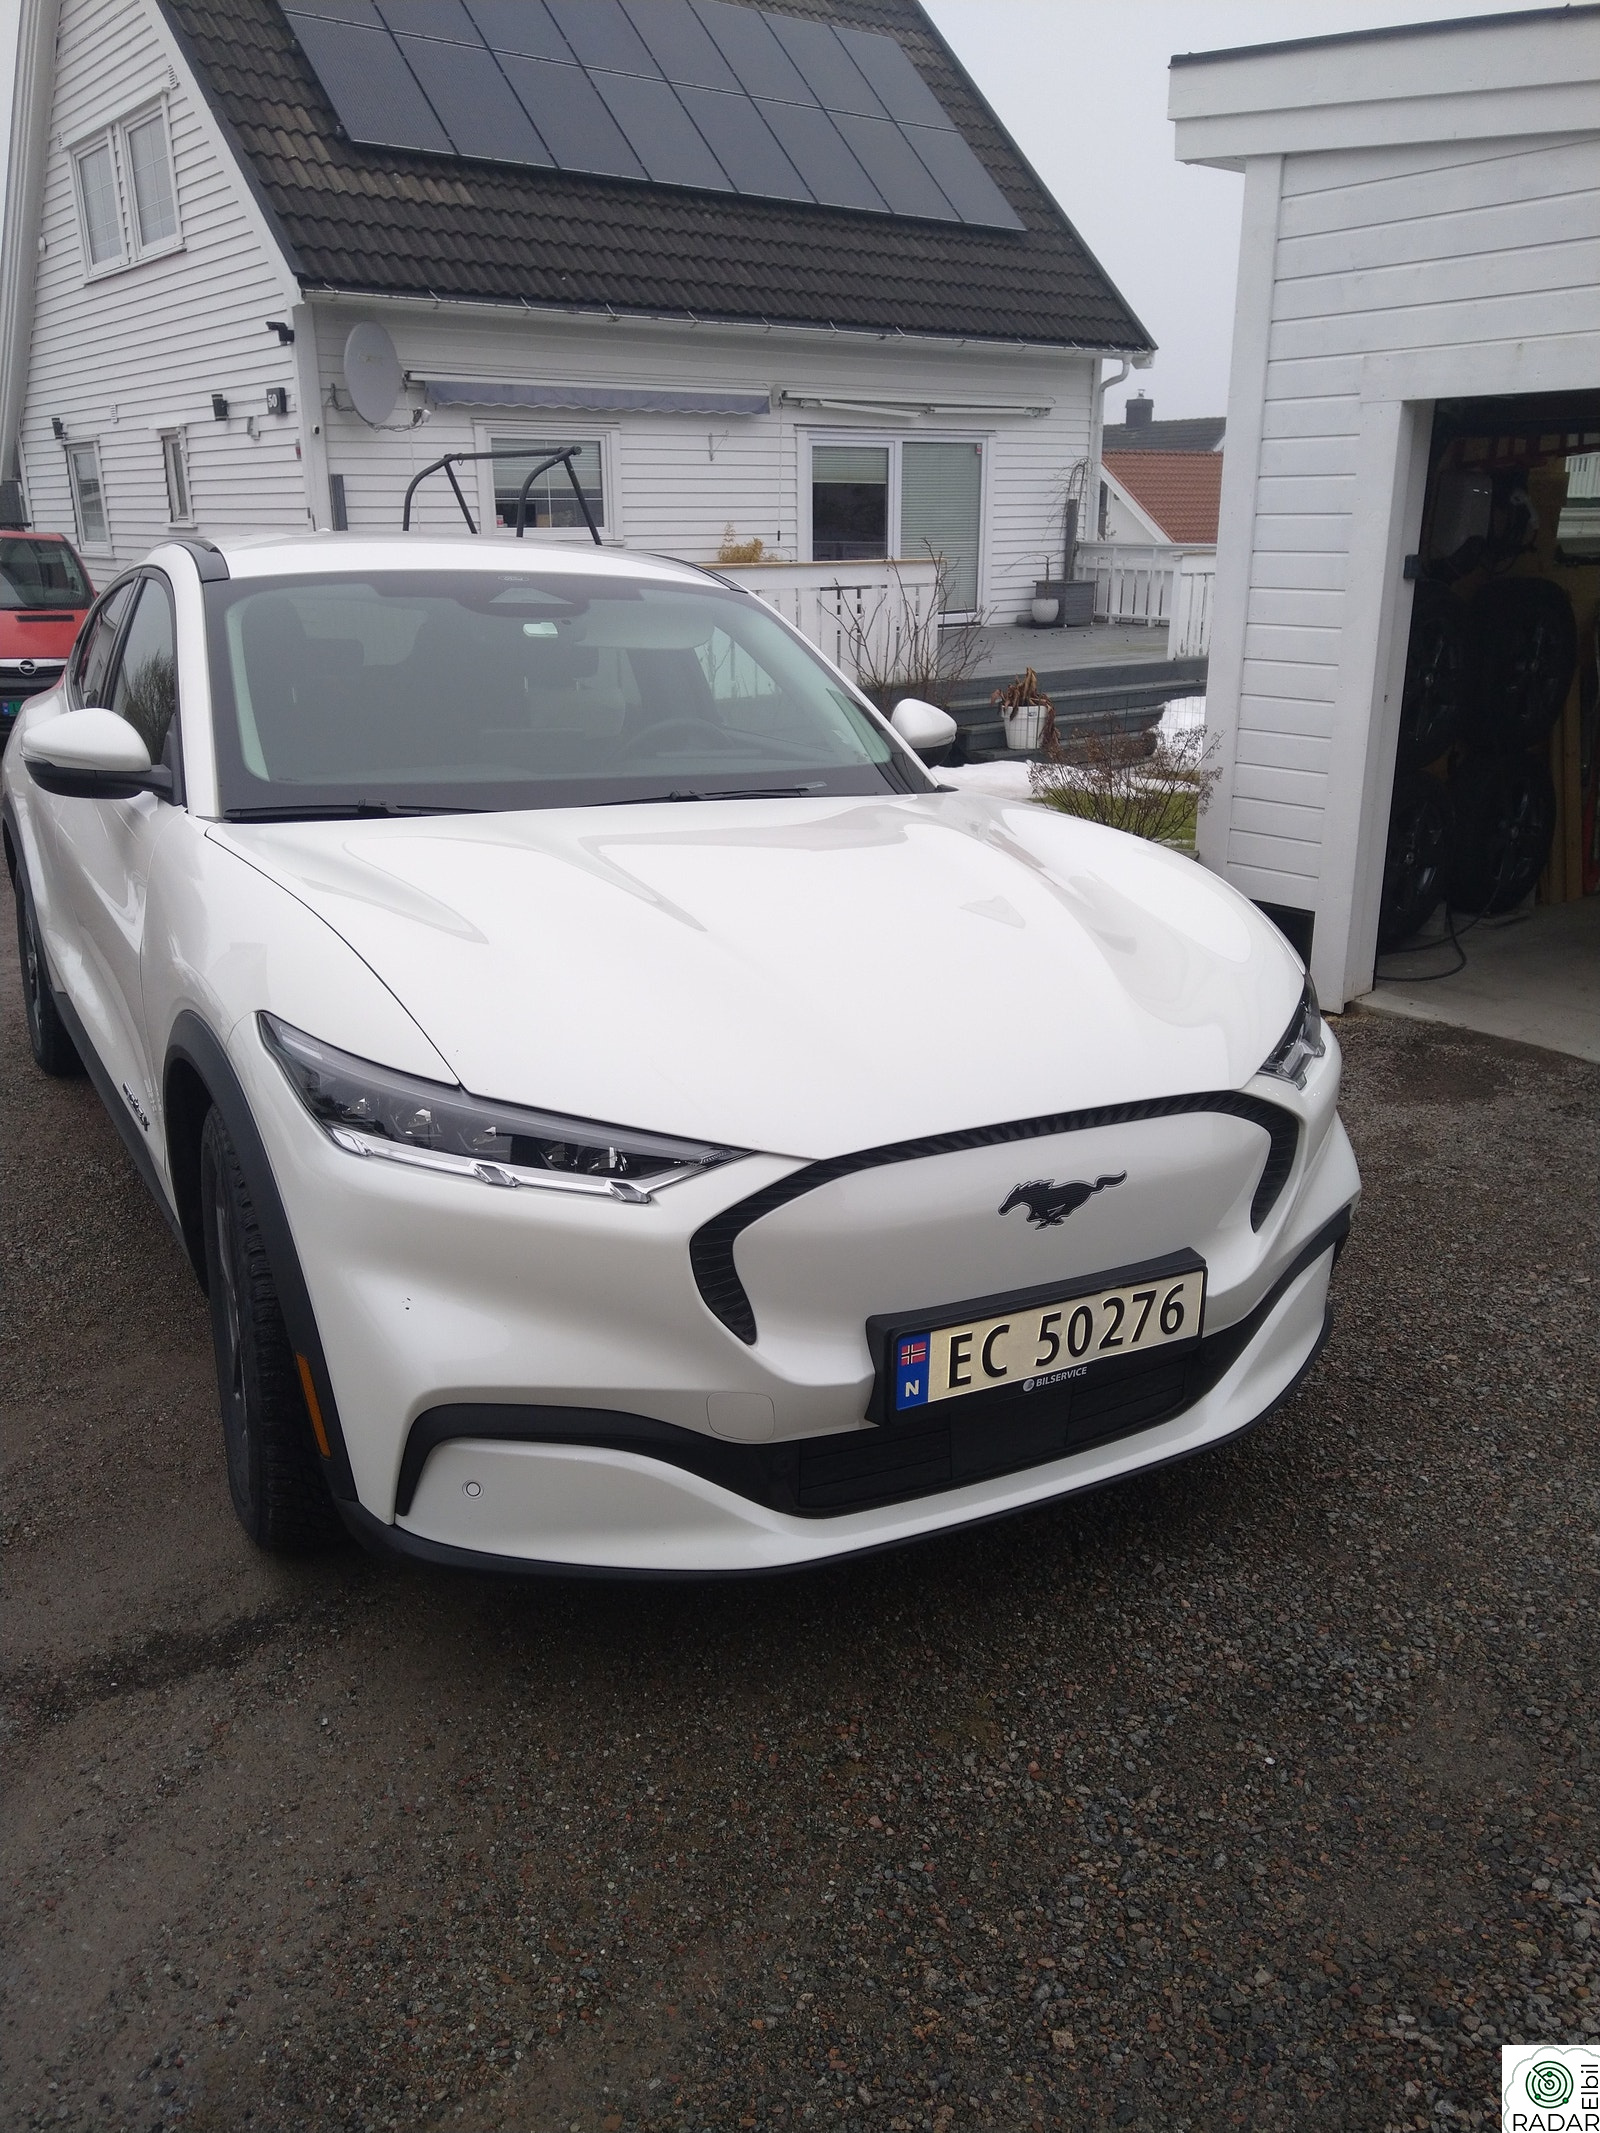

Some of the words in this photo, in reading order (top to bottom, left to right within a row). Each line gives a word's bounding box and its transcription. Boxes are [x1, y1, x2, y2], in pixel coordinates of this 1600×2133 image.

[949, 1324, 1010, 1389] EC
[1034, 1283, 1185, 1367] 50276
[1036, 1366, 1088, 1387] BILSERVICE
[905, 1379, 920, 1398] N
